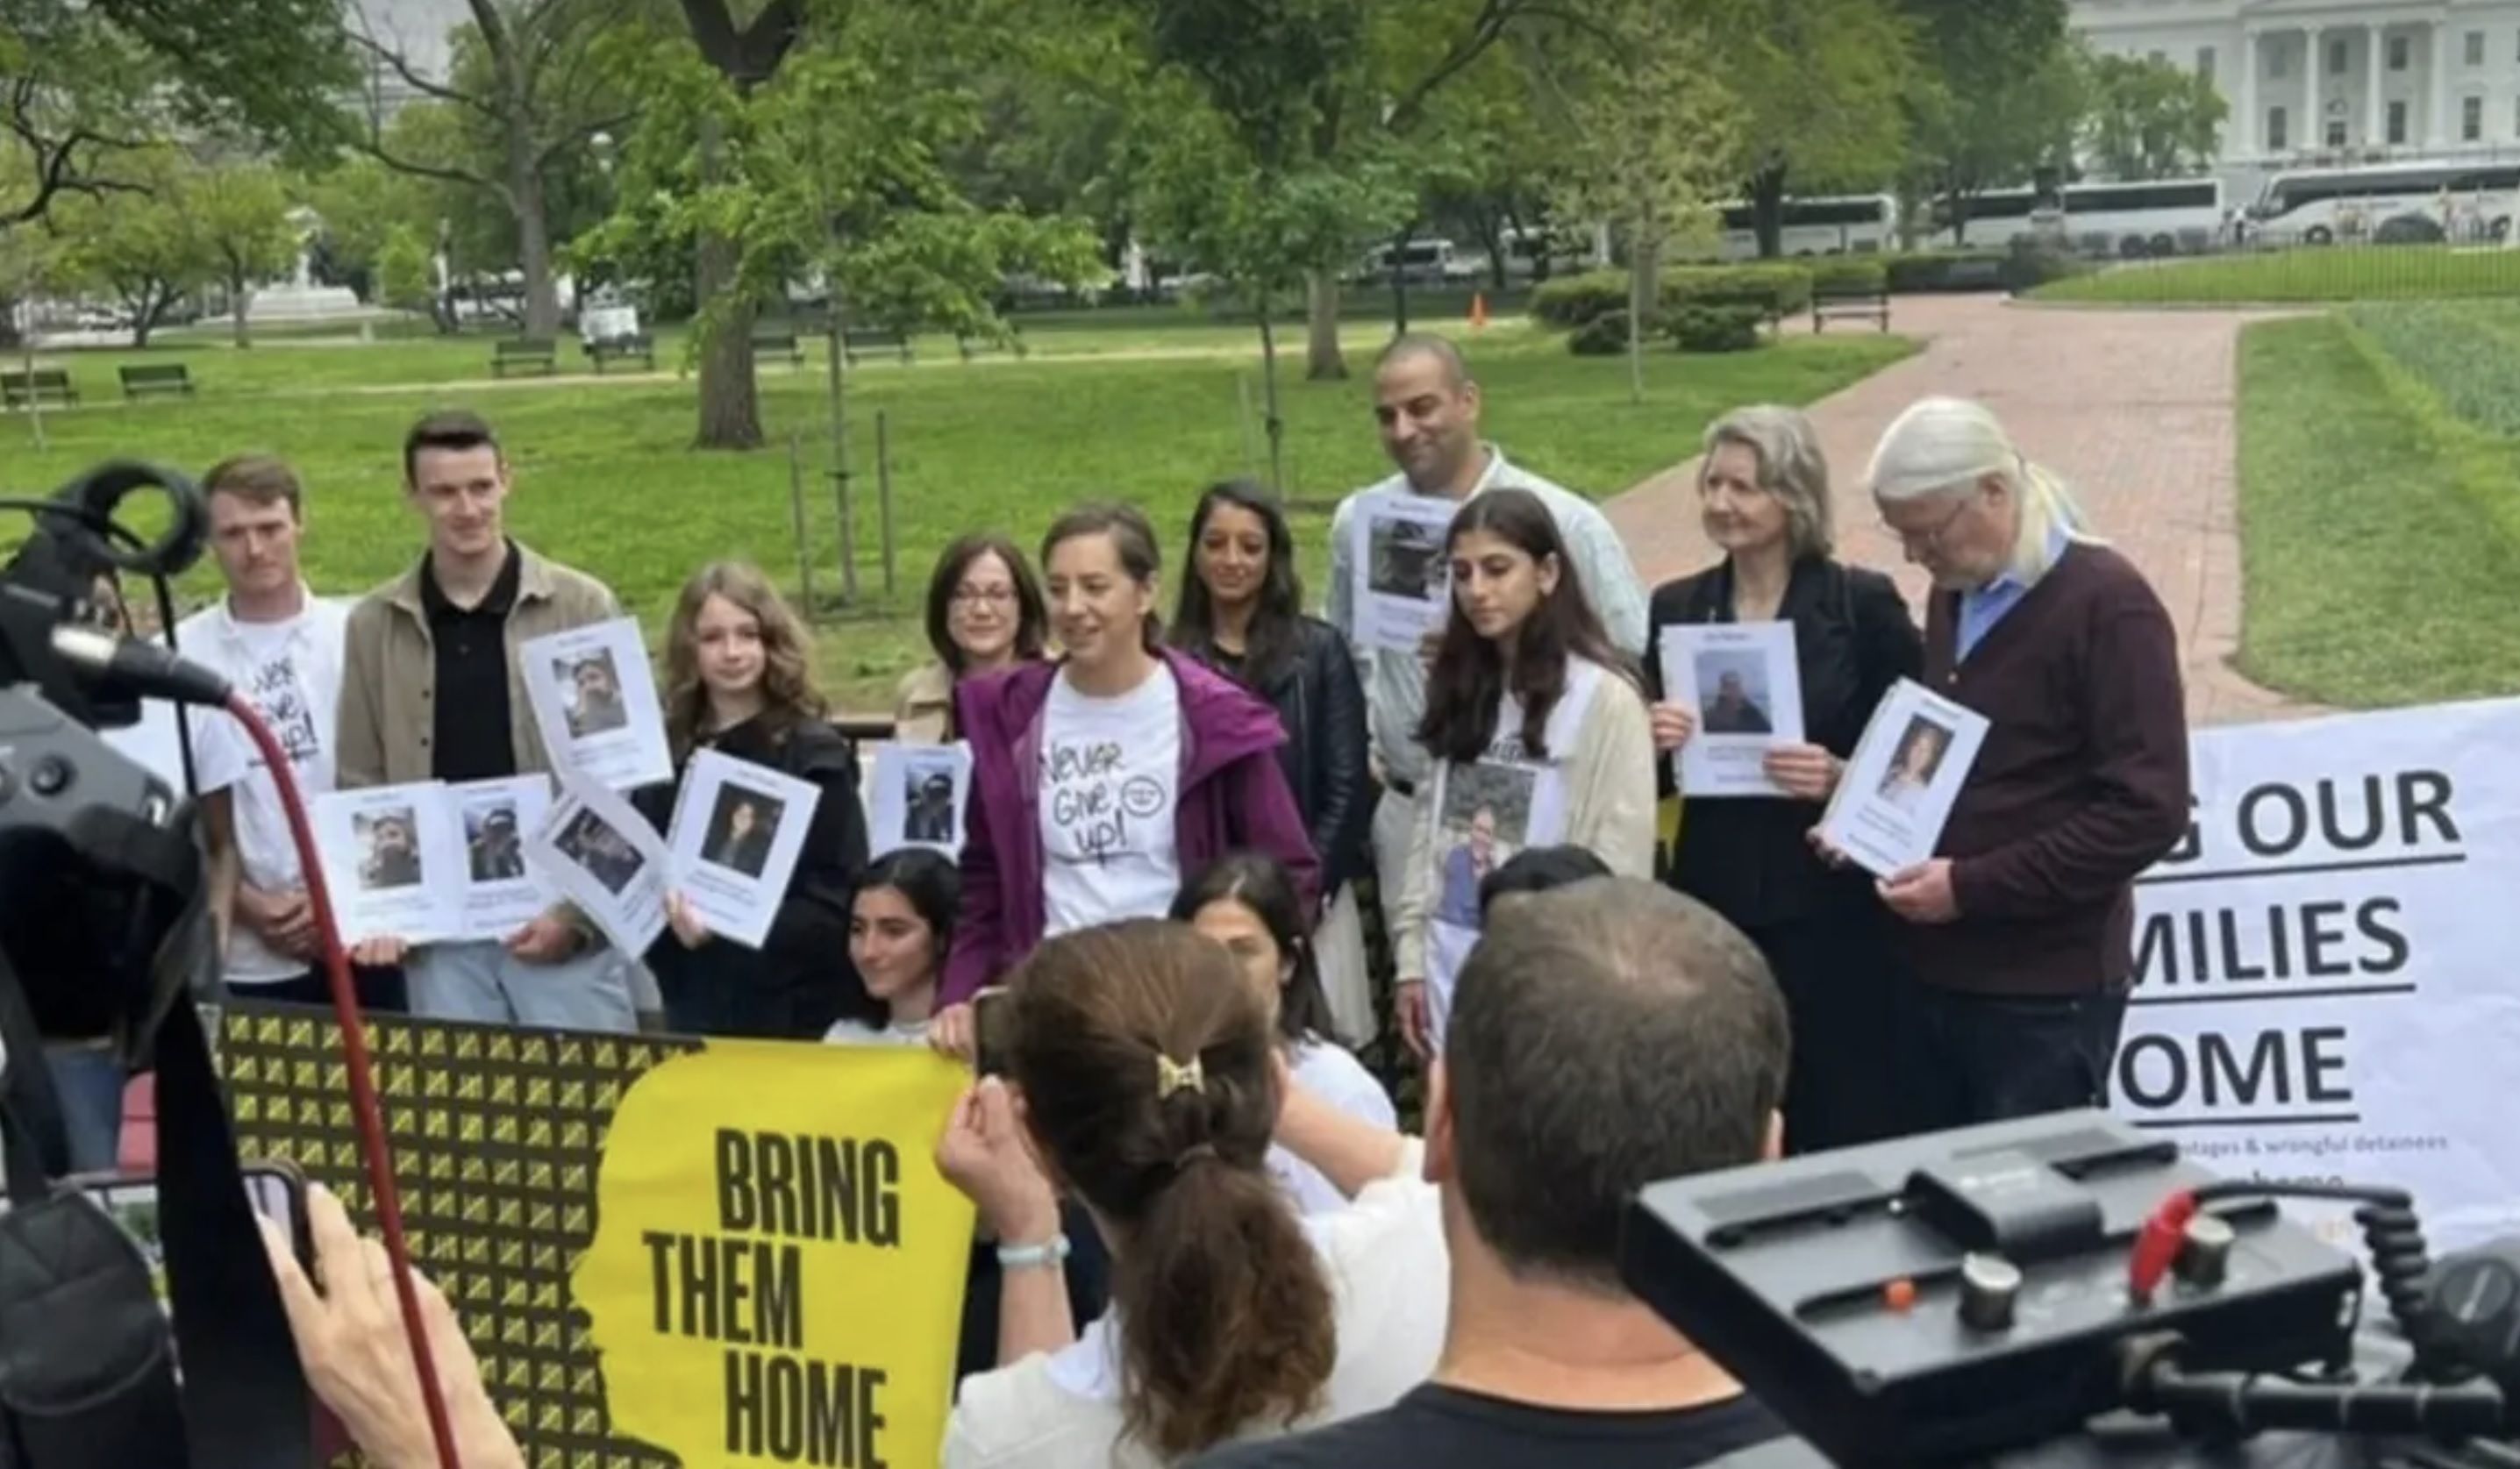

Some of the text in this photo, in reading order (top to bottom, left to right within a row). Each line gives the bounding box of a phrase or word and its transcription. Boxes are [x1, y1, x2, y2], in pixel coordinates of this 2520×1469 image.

[1075, 807, 1127, 868] up!
[2238, 770, 2461, 857] OUR
[2118, 1026, 2353, 1109] OME
[715, 1127, 900, 1248] BRING
[2265, 1133, 2349, 1159] wrongful
[2353, 1134, 2448, 1155] detainees
[642, 1229, 803, 1350] THEM
[725, 1349, 889, 1469] HOME
